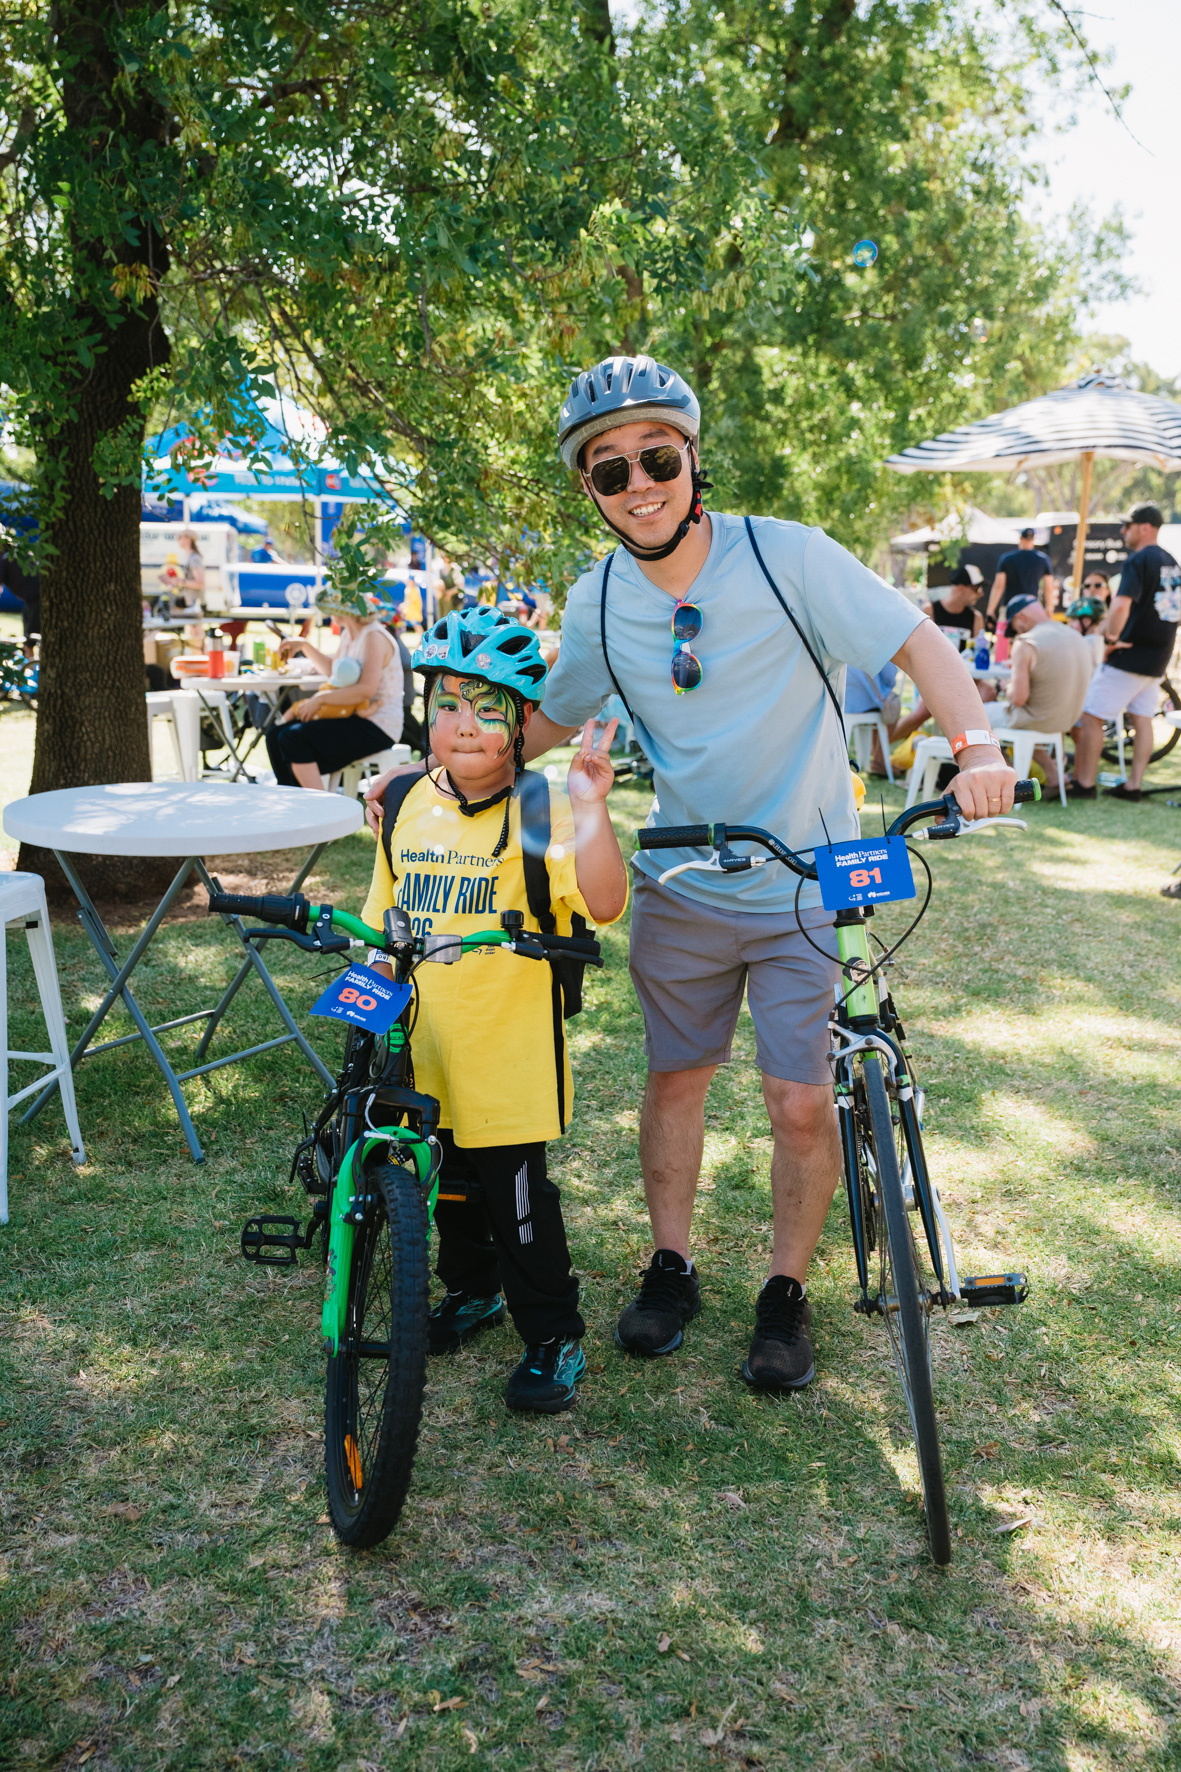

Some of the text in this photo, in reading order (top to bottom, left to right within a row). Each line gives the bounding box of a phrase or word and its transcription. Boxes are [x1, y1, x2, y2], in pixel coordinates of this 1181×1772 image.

[400, 848, 446, 863] Health
[834, 849, 888, 862] Health Partners
[836, 854, 889, 868] FAMILY RIDE
[849, 867, 882, 888] 81
[454, 876, 499, 914] RIDE
[345, 976, 391, 1000] FAMILY RIDE
[347, 971, 393, 996] Health Partners
[338, 988, 378, 1011] 80
